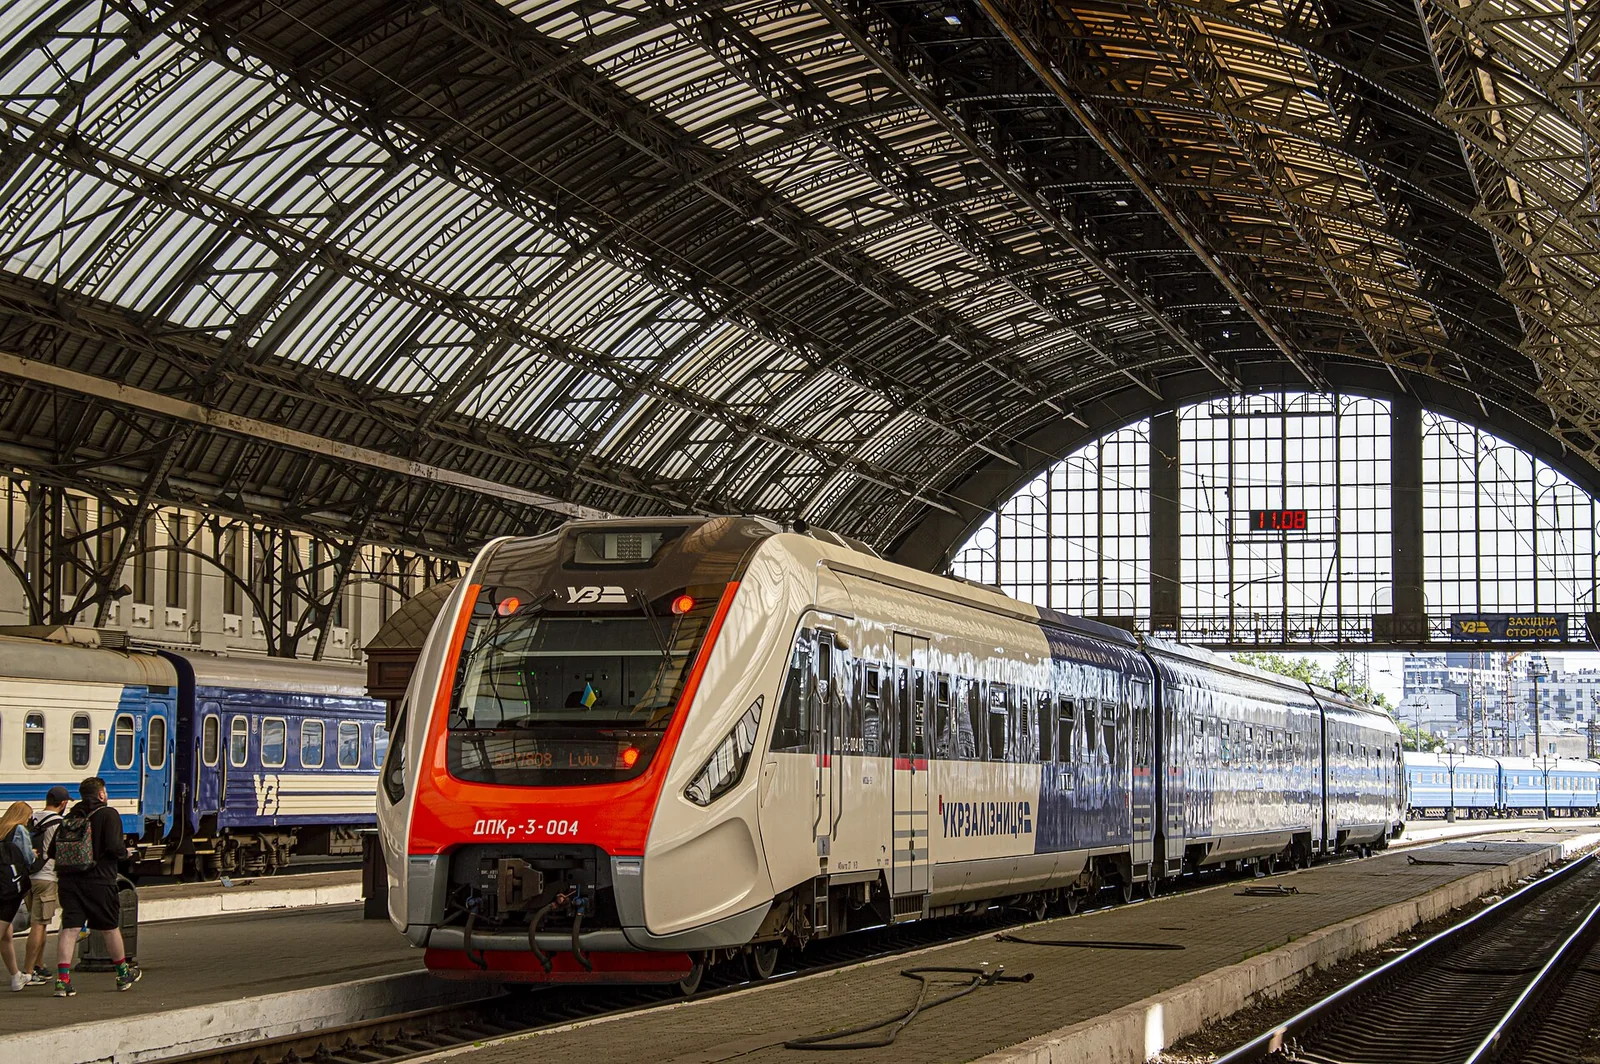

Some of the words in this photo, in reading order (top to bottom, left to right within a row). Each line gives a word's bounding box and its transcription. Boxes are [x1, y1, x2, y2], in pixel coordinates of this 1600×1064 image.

[1508, 617, 1557, 627] ЗАХІДНА
[1506, 628, 1560, 637] СТОРОНА
[569, 753, 599, 767] Lviv
[942, 801, 1024, 839] УКРЗАЛІЗНИЦЯ
